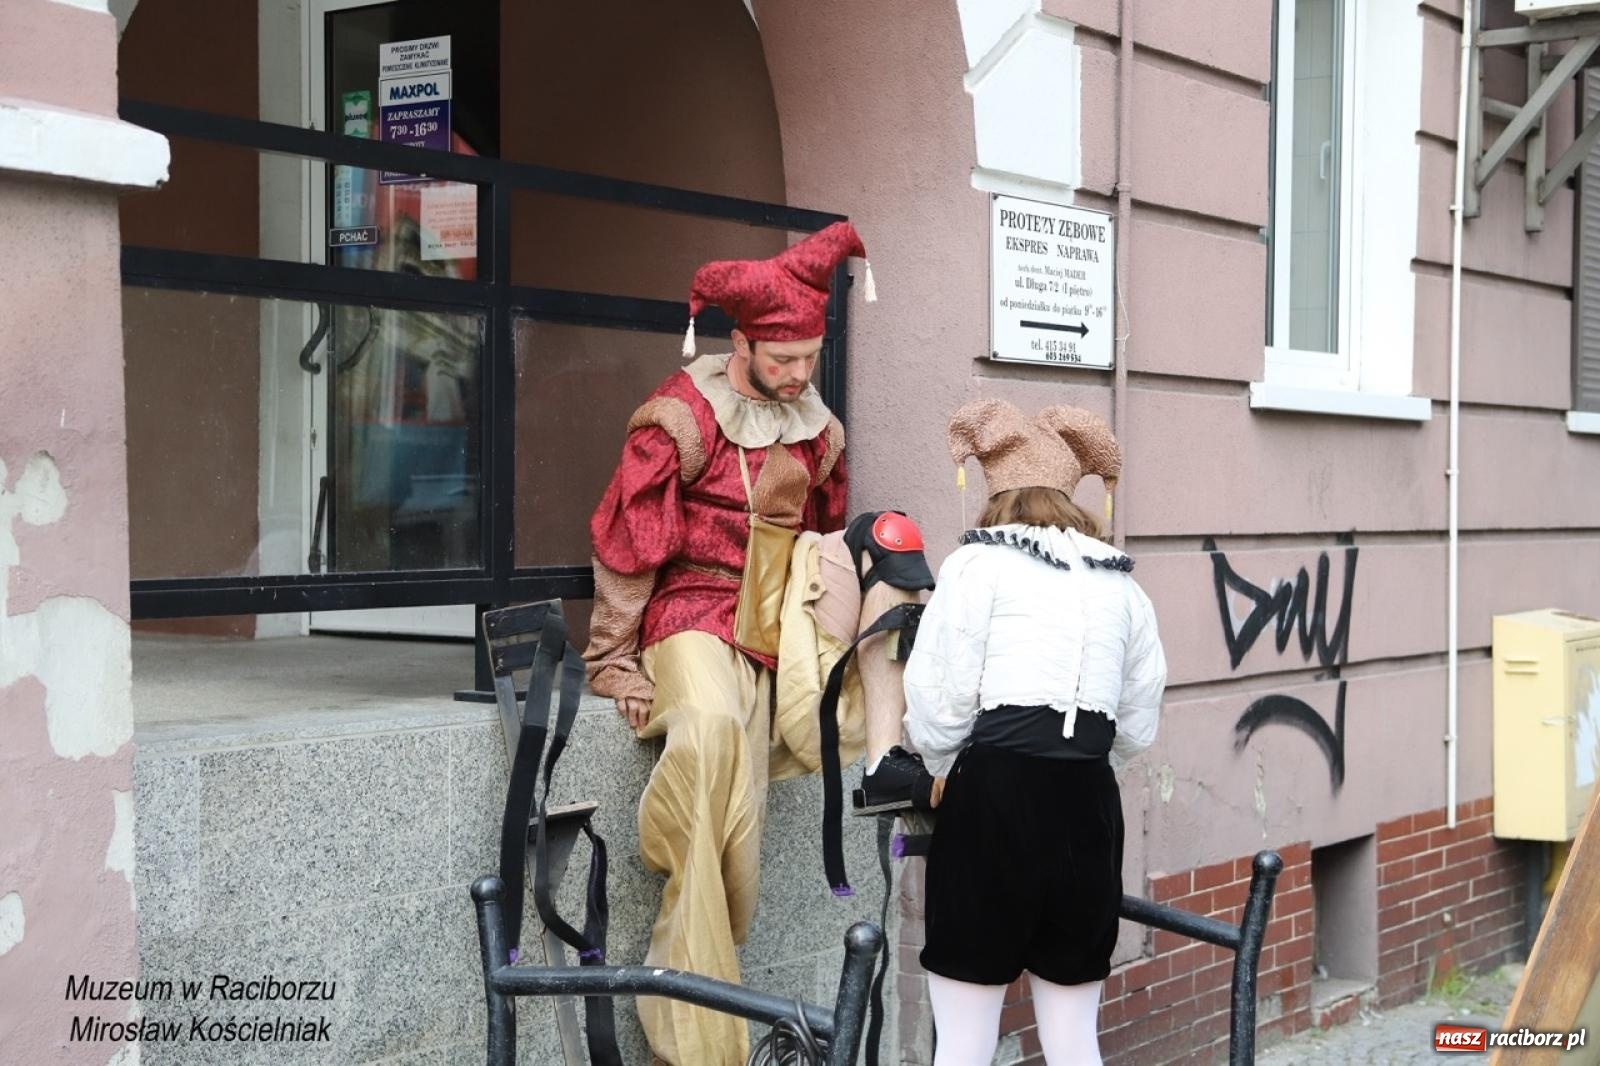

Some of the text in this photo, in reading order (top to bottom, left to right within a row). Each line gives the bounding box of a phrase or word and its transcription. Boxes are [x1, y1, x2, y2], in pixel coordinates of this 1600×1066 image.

[389, 82, 440, 100] MAXPOL
[387, 107, 440, 121] ZAPRASZAMY
[1000, 209, 1106, 243] PROTEZY ZĘBOWE
[339, 231, 368, 242] PCHAĆ
[1005, 236, 1099, 263] EKSPRES NAPRAWA
[1014, 276, 1024, 288] ul.
[1026, 277, 1047, 293] Długa
[1000, 297, 1008, 307] od
[1031, 338, 1043, 350] tel.
